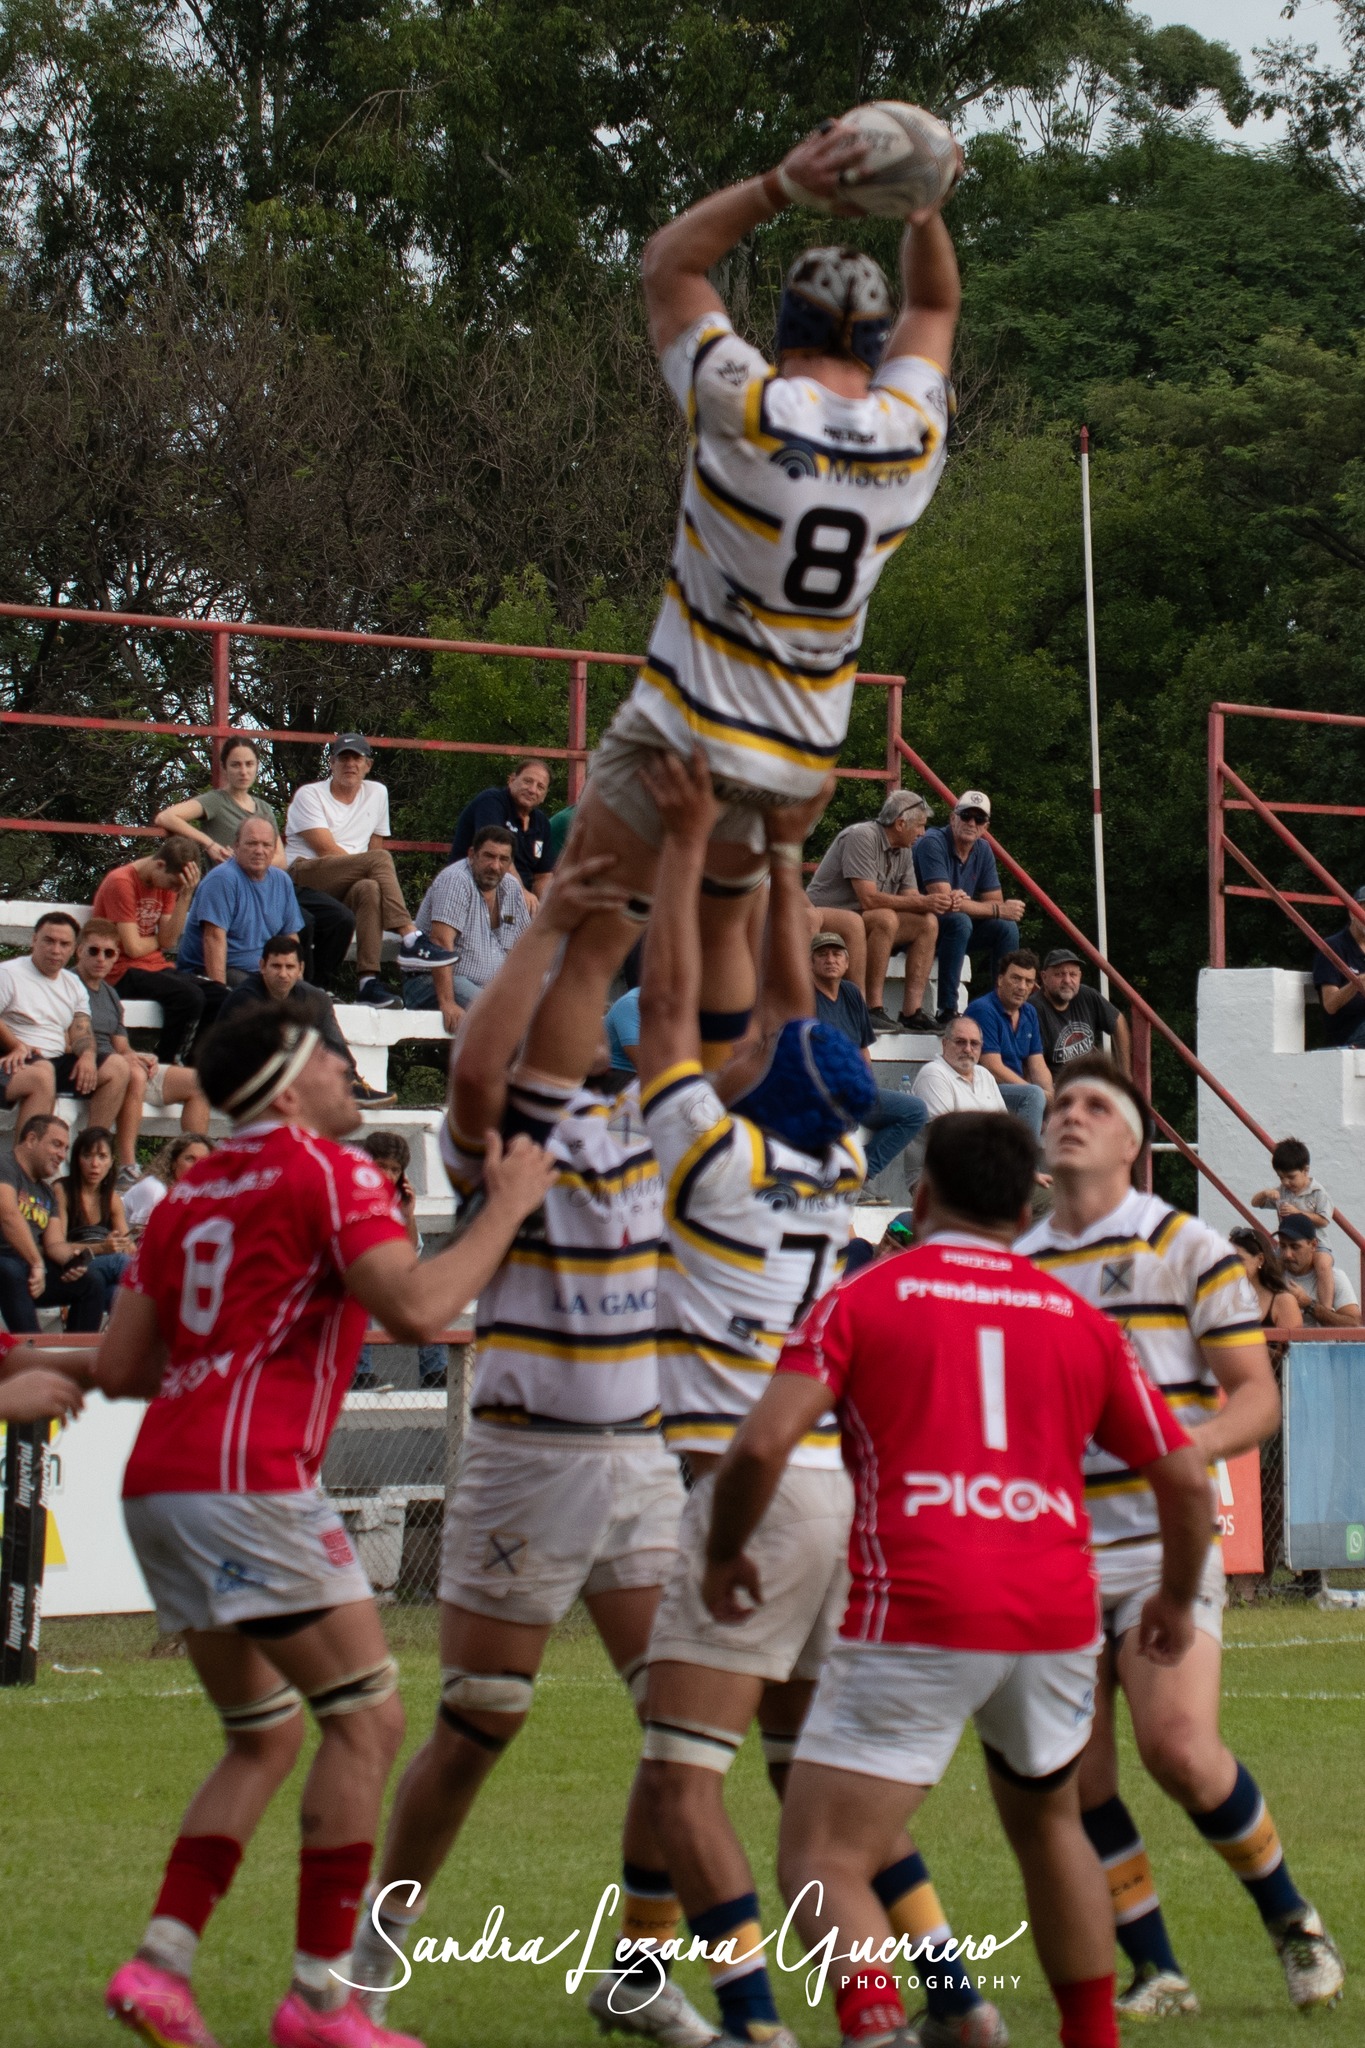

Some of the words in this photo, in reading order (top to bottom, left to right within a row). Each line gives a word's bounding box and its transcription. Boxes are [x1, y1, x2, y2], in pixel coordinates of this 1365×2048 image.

[784, 508, 867, 608] 8
[180, 1216, 234, 1336] 8
[780, 1233, 828, 1329] 7
[979, 1326, 1008, 1452] 1
[903, 1472, 1076, 1528] PICON
